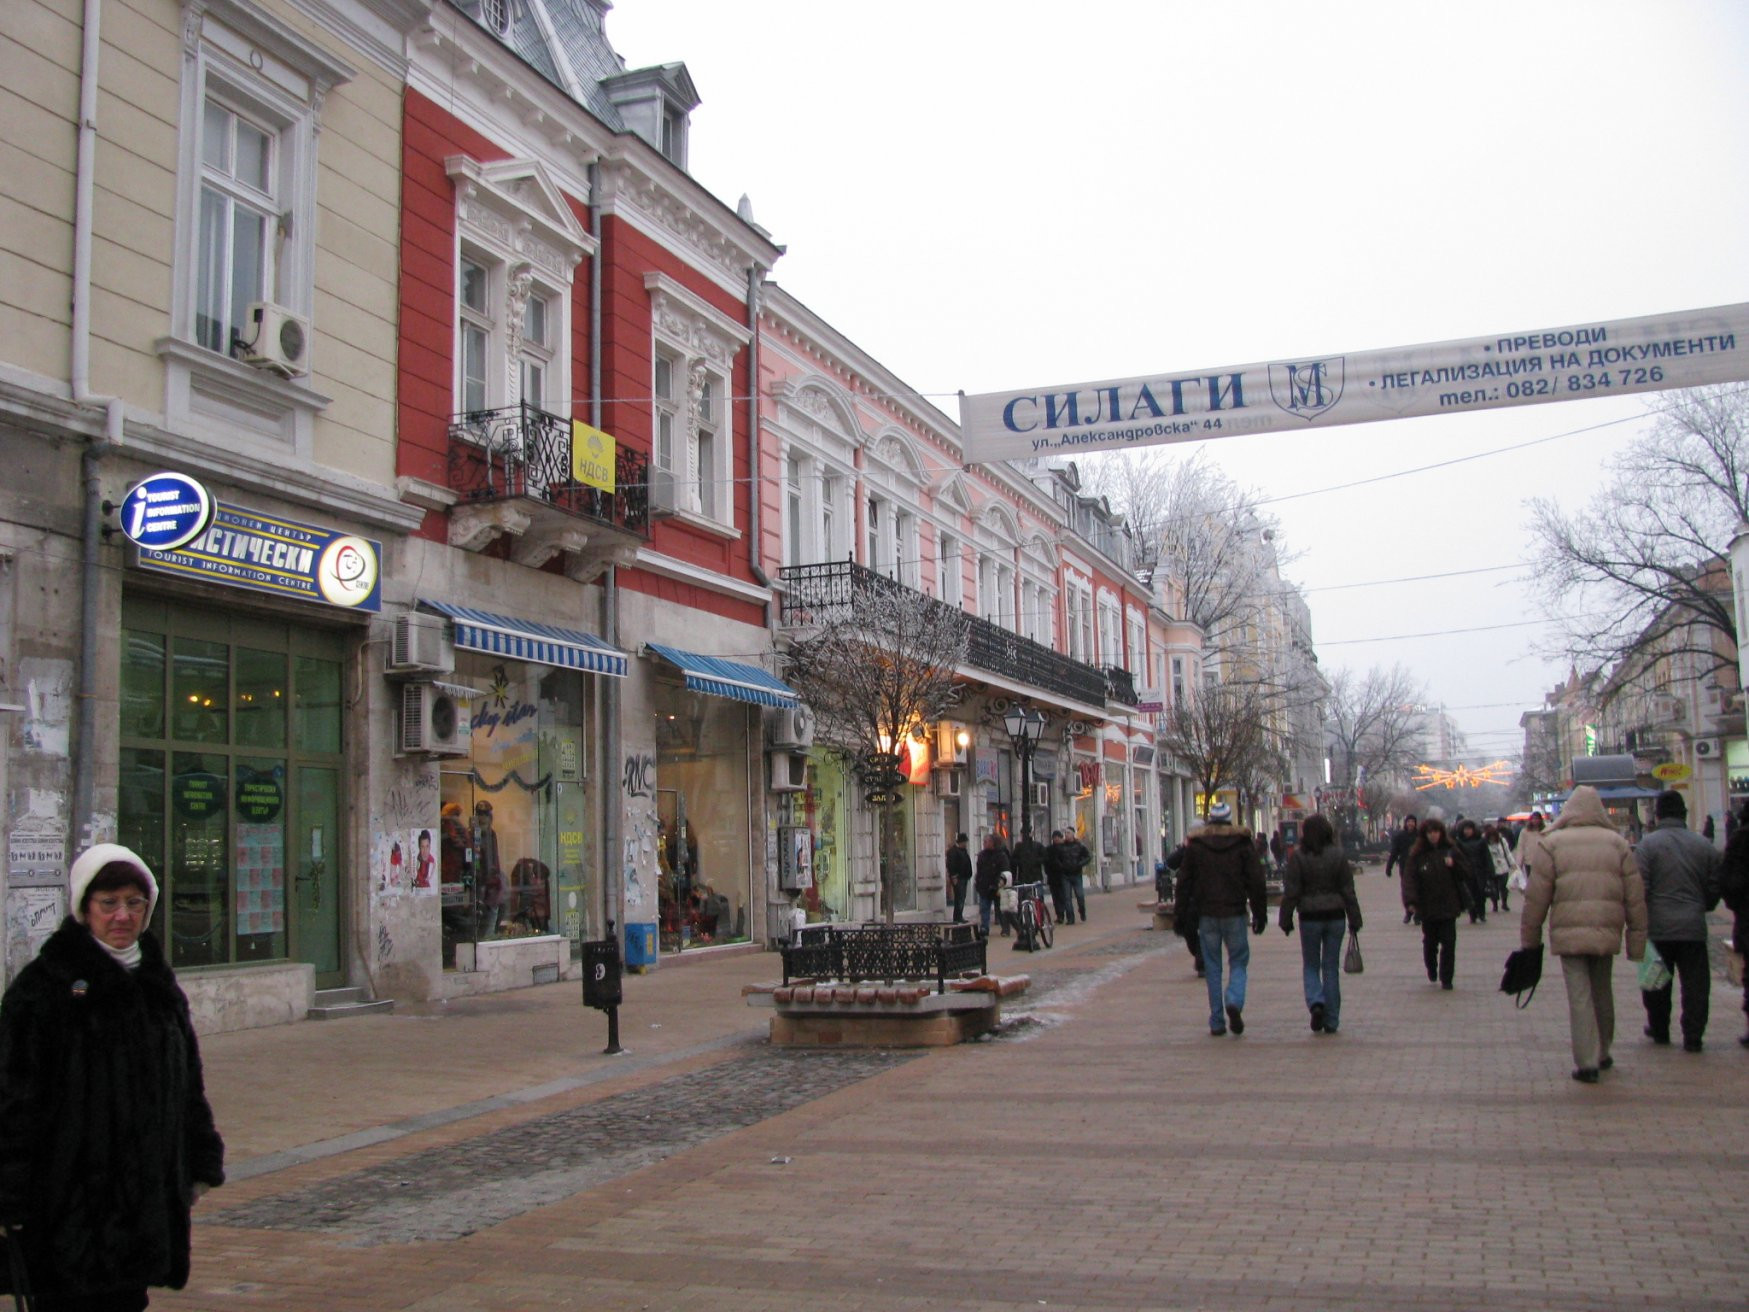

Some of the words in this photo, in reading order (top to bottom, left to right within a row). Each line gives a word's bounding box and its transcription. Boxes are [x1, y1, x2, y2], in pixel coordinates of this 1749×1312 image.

[1497, 327, 1607, 353] ПРЕВОДИ
[1381, 357, 1543, 390] ЛЕГАЛИЗАЦИЯ
[1549, 351, 1581, 369] НА
[1588, 334, 1736, 368] ДОКУМЕНТИ
[1506, 376, 1558, 399] 082/
[1567, 371, 1612, 391] 834
[1619, 366, 1664, 386] 726
[1002, 371, 1250, 433] СИЛАГИ
[1203, 418, 1223, 430] 44
[580, 457, 609, 482] НДСВ
[147, 490, 180, 503] TOURIST
[146, 503, 200, 518] INFORMATION
[146, 520, 177, 532] CENTRE
[270, 525, 312, 541] ЦЕНТЪР
[149, 549, 194, 567] TOURIST
[203, 561, 271, 582] INFORMATION
[278, 577, 312, 591] CENTRE
[560, 832, 583, 846] НДСВ
